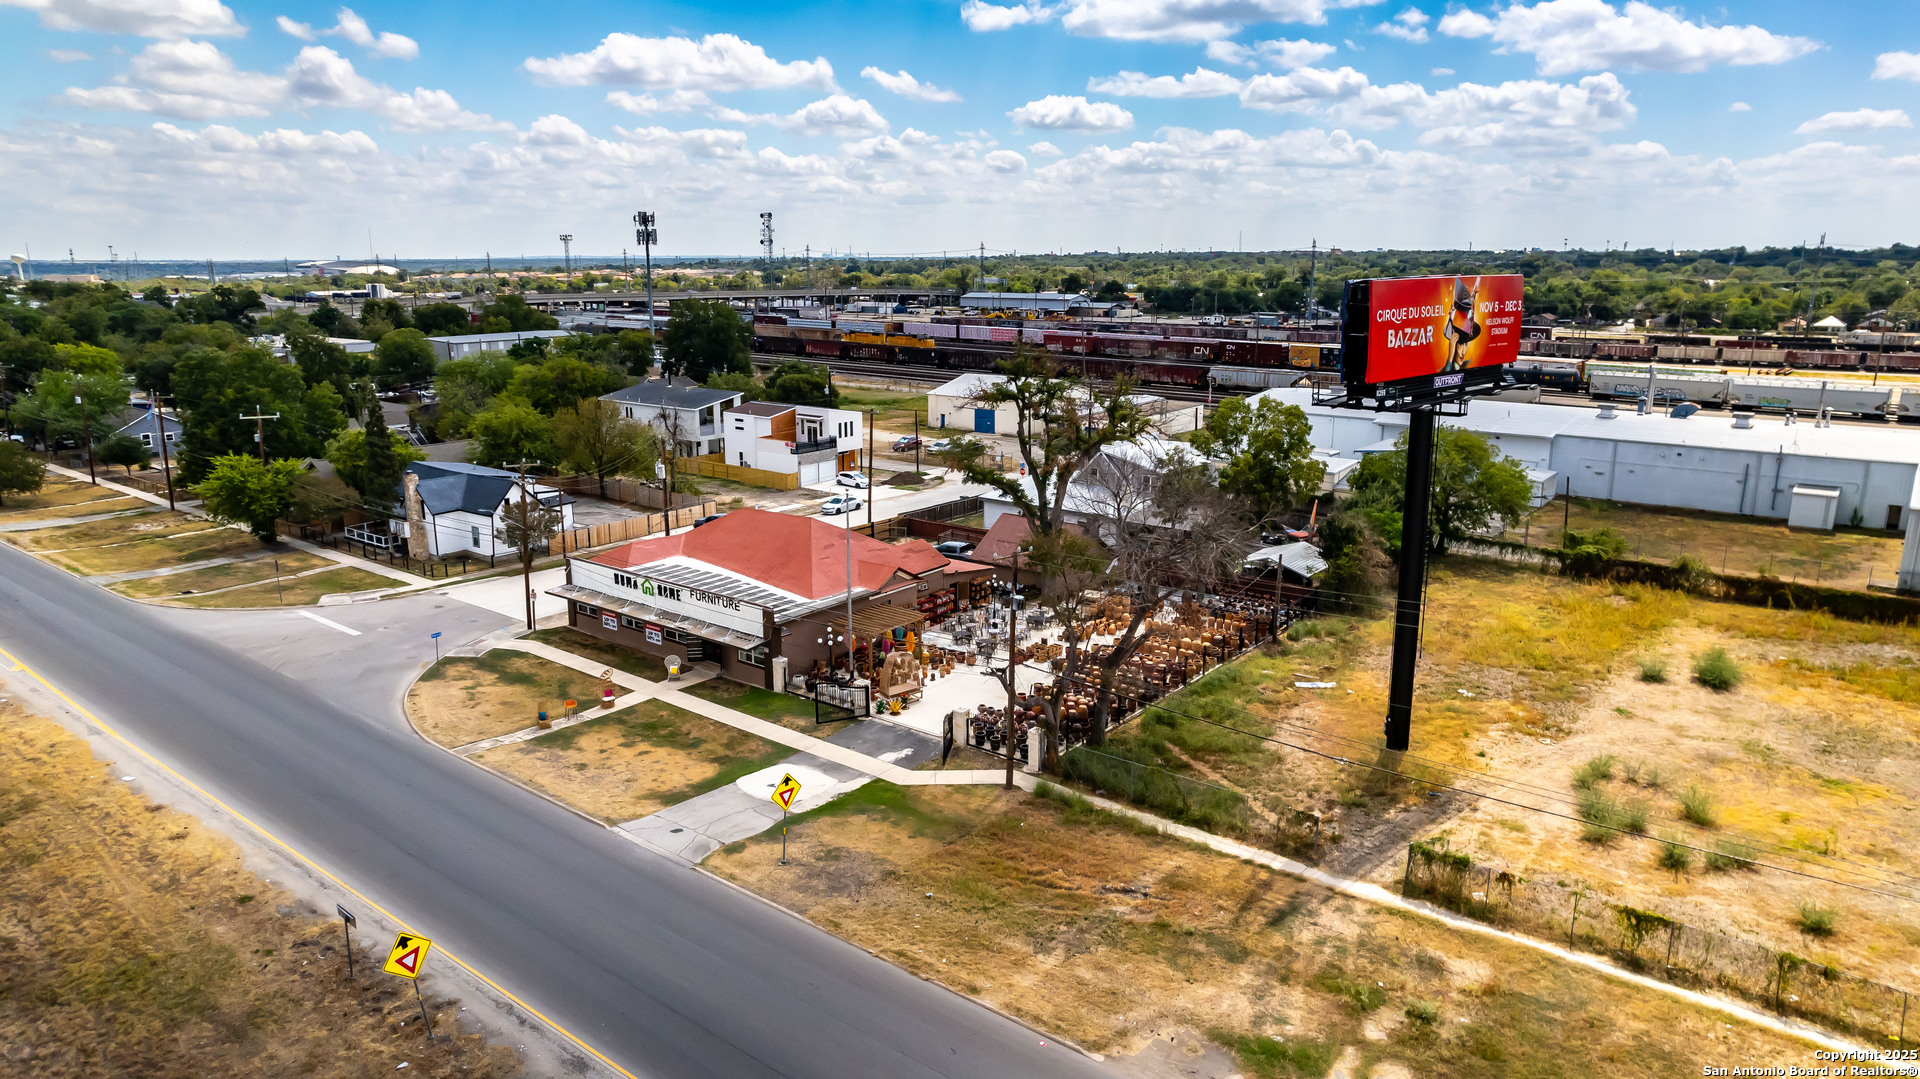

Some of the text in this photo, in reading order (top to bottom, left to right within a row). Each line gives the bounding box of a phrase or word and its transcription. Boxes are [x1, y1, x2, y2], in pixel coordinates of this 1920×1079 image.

[1479, 301, 1494, 313] NOV
[1505, 300, 1517, 312] DEC
[1517, 299, 1522, 311] 3
[1376, 304, 1445, 324] CIRQUE DU SOLEIL
[1485, 316, 1515, 326] NELSON WOLFF
[1387, 325, 1434, 349] BAZZAR
[1491, 327, 1508, 336] STADIUM
[1529, 332, 1546, 340] CN
[1193, 346, 1209, 354] CN
[1434, 375, 1463, 387] OUTFRONT
[689, 588, 741, 612] FURNITURE
